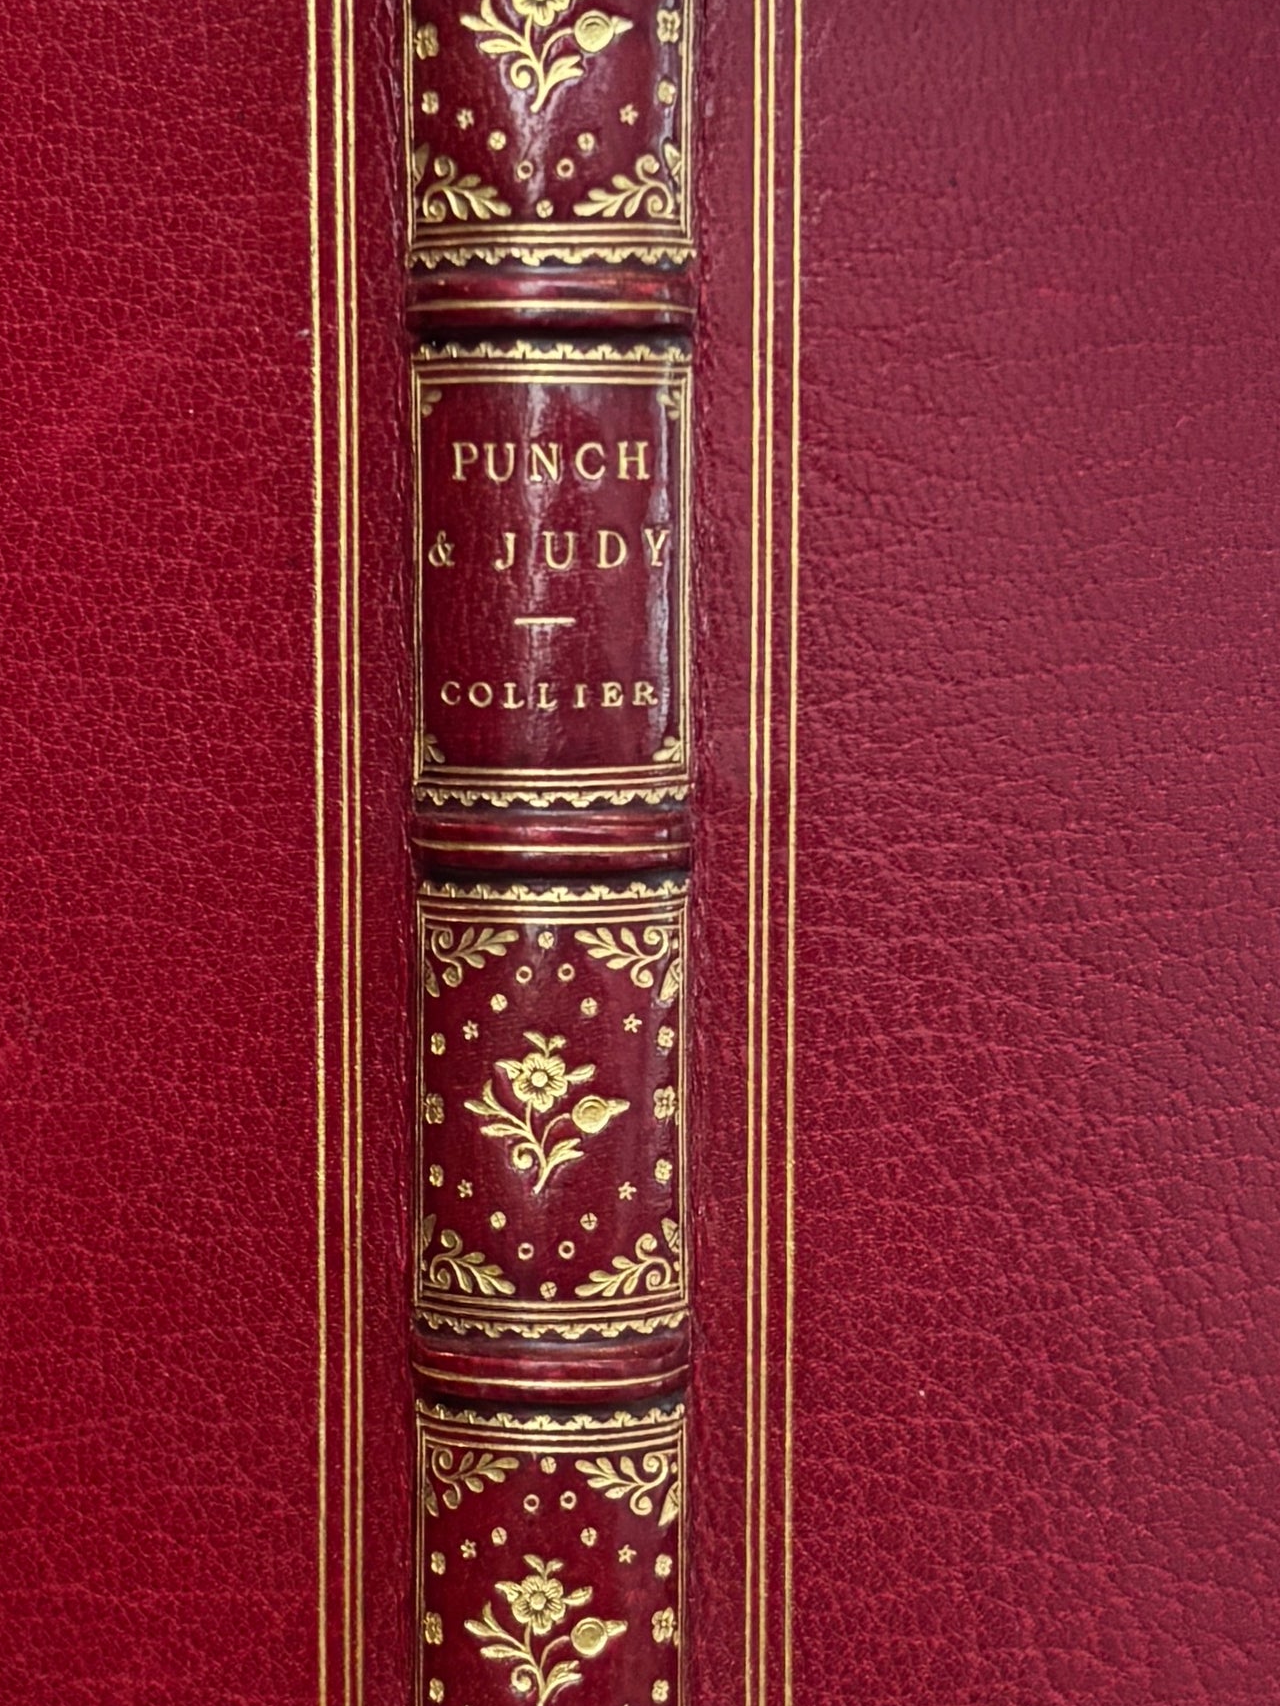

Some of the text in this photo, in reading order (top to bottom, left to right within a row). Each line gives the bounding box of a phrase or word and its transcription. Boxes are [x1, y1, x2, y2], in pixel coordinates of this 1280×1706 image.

[451, 441, 651, 482] PUNCH
[428, 528, 671, 572] & JUDY
[440, 680, 659, 710] COLLIER
